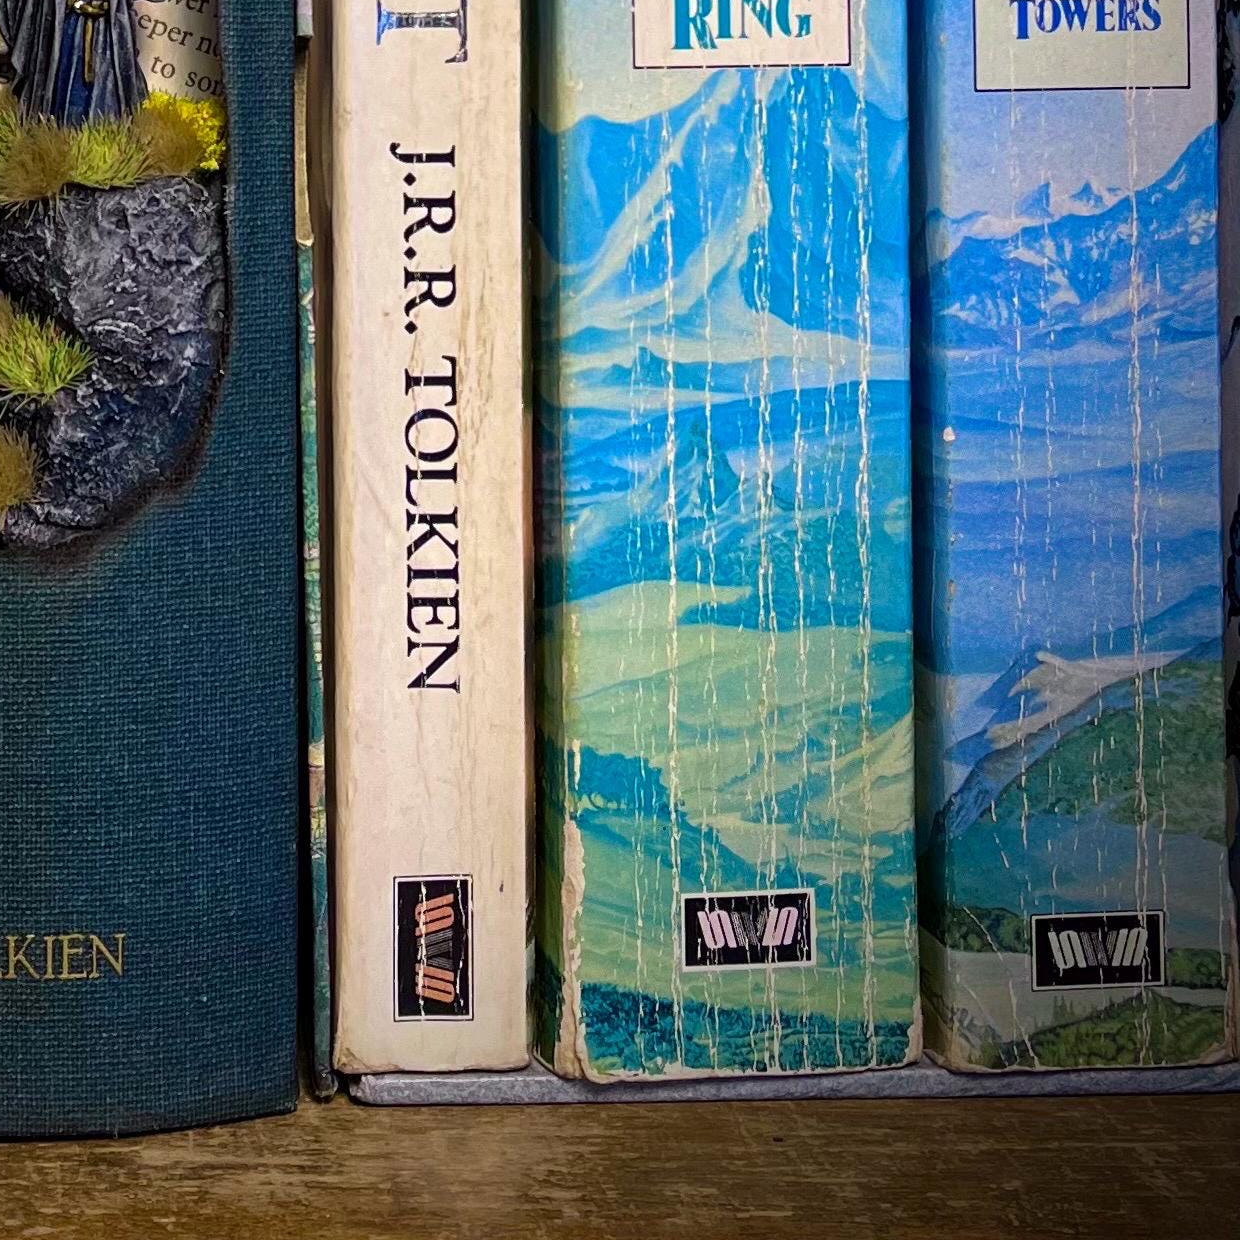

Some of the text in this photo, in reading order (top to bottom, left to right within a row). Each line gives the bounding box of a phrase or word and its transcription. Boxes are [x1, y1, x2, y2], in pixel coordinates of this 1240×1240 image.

[151, 55, 176, 79] to
[390, 143, 461, 695] J.R.R. TOLKIEN
